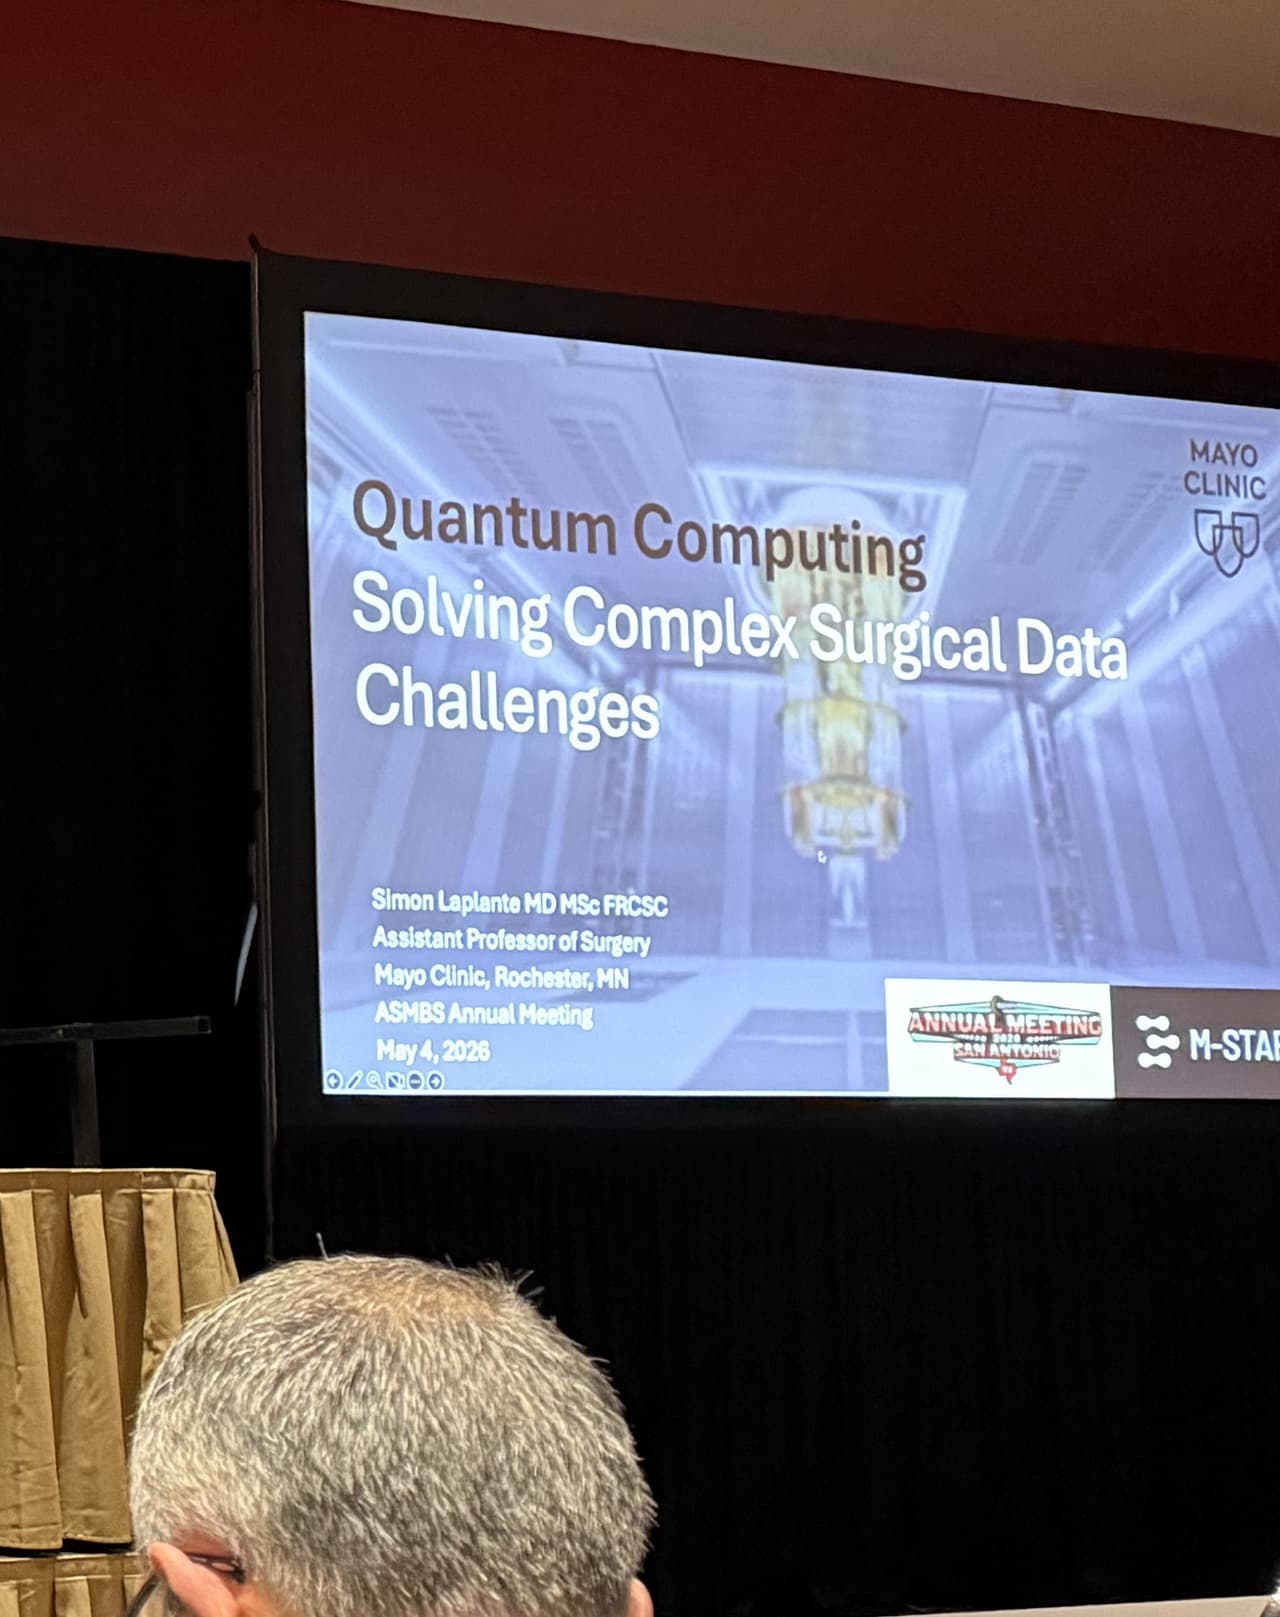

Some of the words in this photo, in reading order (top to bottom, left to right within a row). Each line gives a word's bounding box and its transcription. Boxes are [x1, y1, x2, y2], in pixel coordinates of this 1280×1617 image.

[1189, 438, 1259, 468] MAYO
[1183, 470, 1267, 501] CLINIC
[353, 479, 617, 555] Quantum
[634, 502, 927, 593] Computing
[352, 570, 553, 658] Solving
[563, 585, 800, 668] Complex
[809, 602, 1007, 681] Surgical
[1017, 617, 1128, 680] Data
[356, 662, 660, 751] Challenges
[371, 887, 435, 912] Simon
[438, 889, 521, 918] Laplante
[523, 892, 557, 915] MD
[559, 892, 601, 917] MSc
[603, 894, 670, 918] FRCSC
[372, 925, 464, 950] Assistant
[466, 927, 556, 952] Professor
[558, 930, 579, 952] of
[580, 930, 652, 958] Surgery
[374, 962, 427, 991] Mayo
[429, 963, 491, 991] Clinic,
[495, 965, 594, 993] Rochester,
[596, 967, 630, 990] MN
[374, 1000, 446, 1024] ASMBS
[447, 1001, 517, 1025] Annual
[518, 1002, 594, 1031] Meeting
[909, 1012, 1004, 1033] ANNUAL
[1006, 1014, 1102, 1036] MEETING
[376, 1038, 419, 1067] May
[419, 1039, 440, 1065] 4,
[442, 1039, 491, 1062] 2026
[954, 1042, 986, 1058] SAN
[989, 1044, 1061, 1058] ANTONIO
